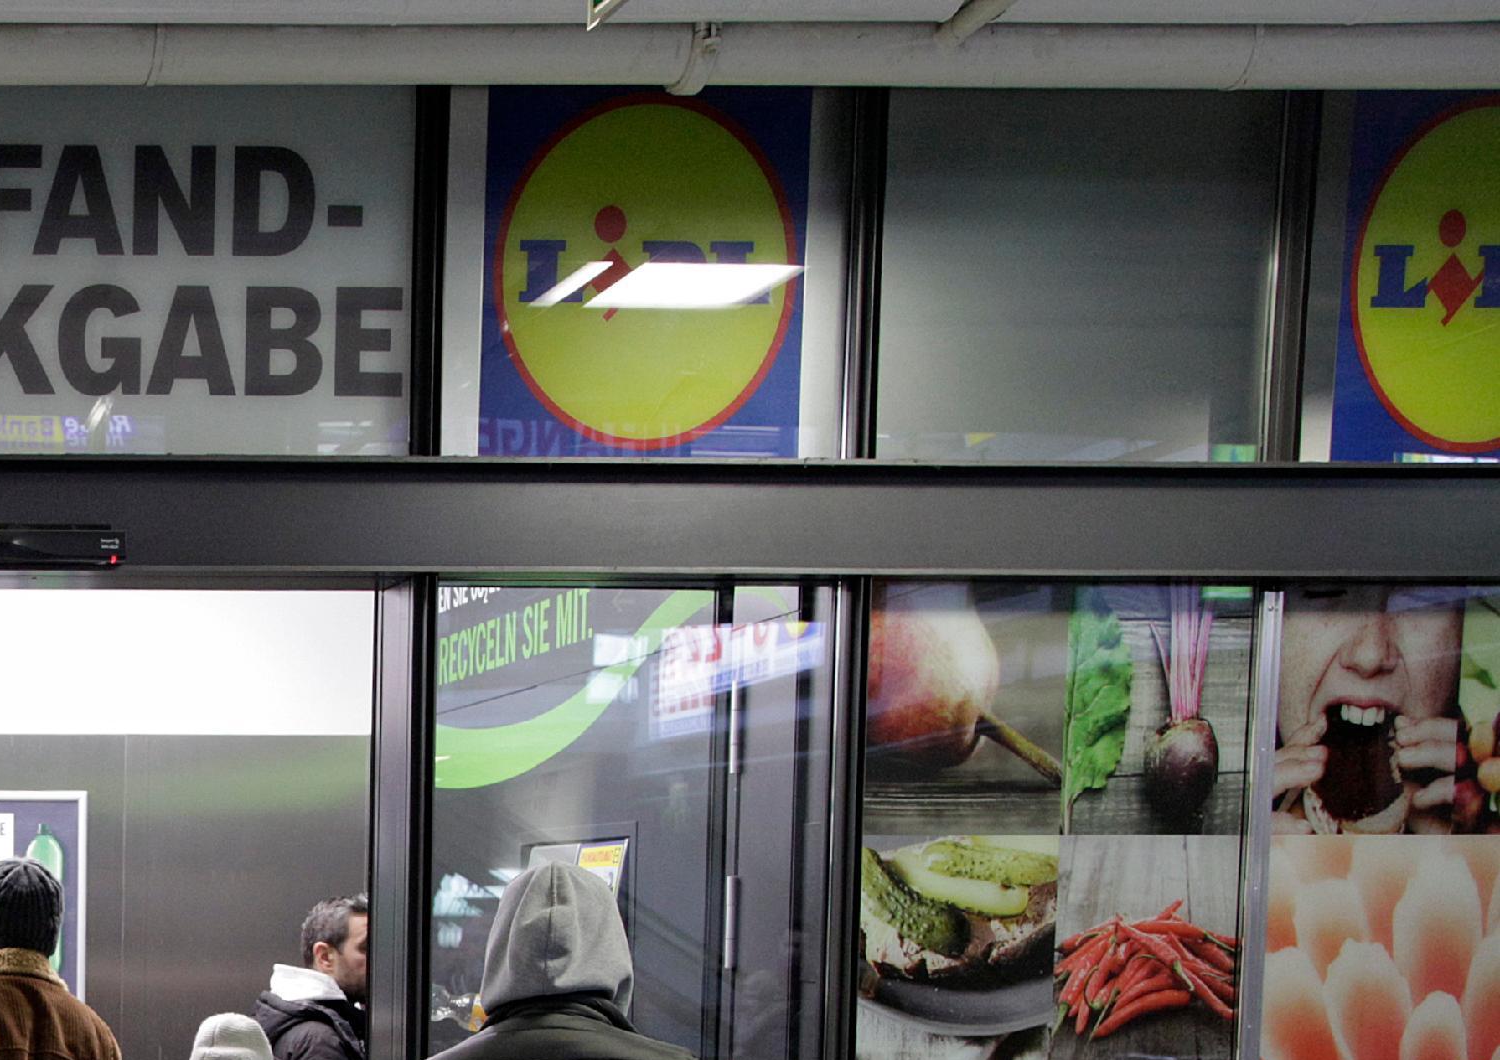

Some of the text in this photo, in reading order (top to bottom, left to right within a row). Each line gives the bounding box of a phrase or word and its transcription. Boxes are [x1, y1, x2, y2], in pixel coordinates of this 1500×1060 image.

[437, 588, 593, 686] RECYCELN SIE MIT.
